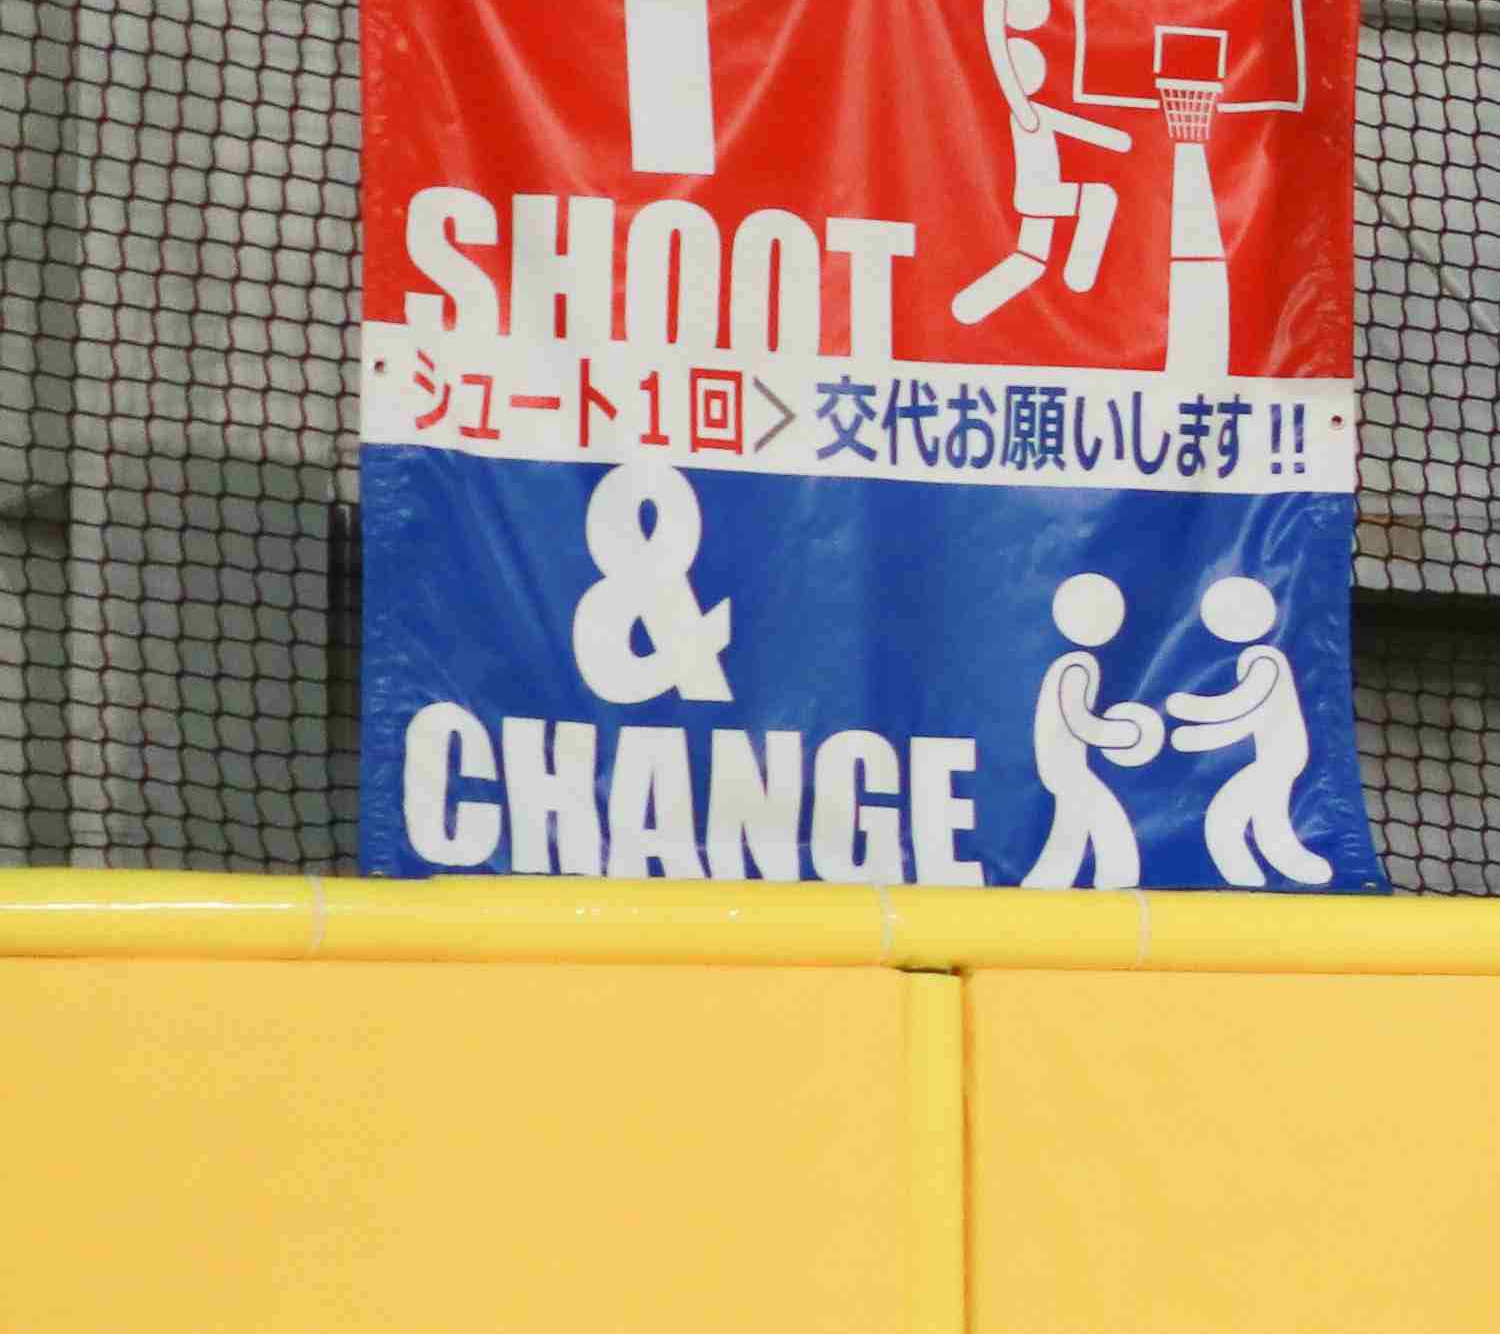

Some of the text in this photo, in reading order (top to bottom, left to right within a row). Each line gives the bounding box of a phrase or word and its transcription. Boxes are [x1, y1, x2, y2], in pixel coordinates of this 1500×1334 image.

[404, 186, 917, 363] SHOOT
[571, 462, 737, 706] &
[402, 703, 985, 889] CHANGE
